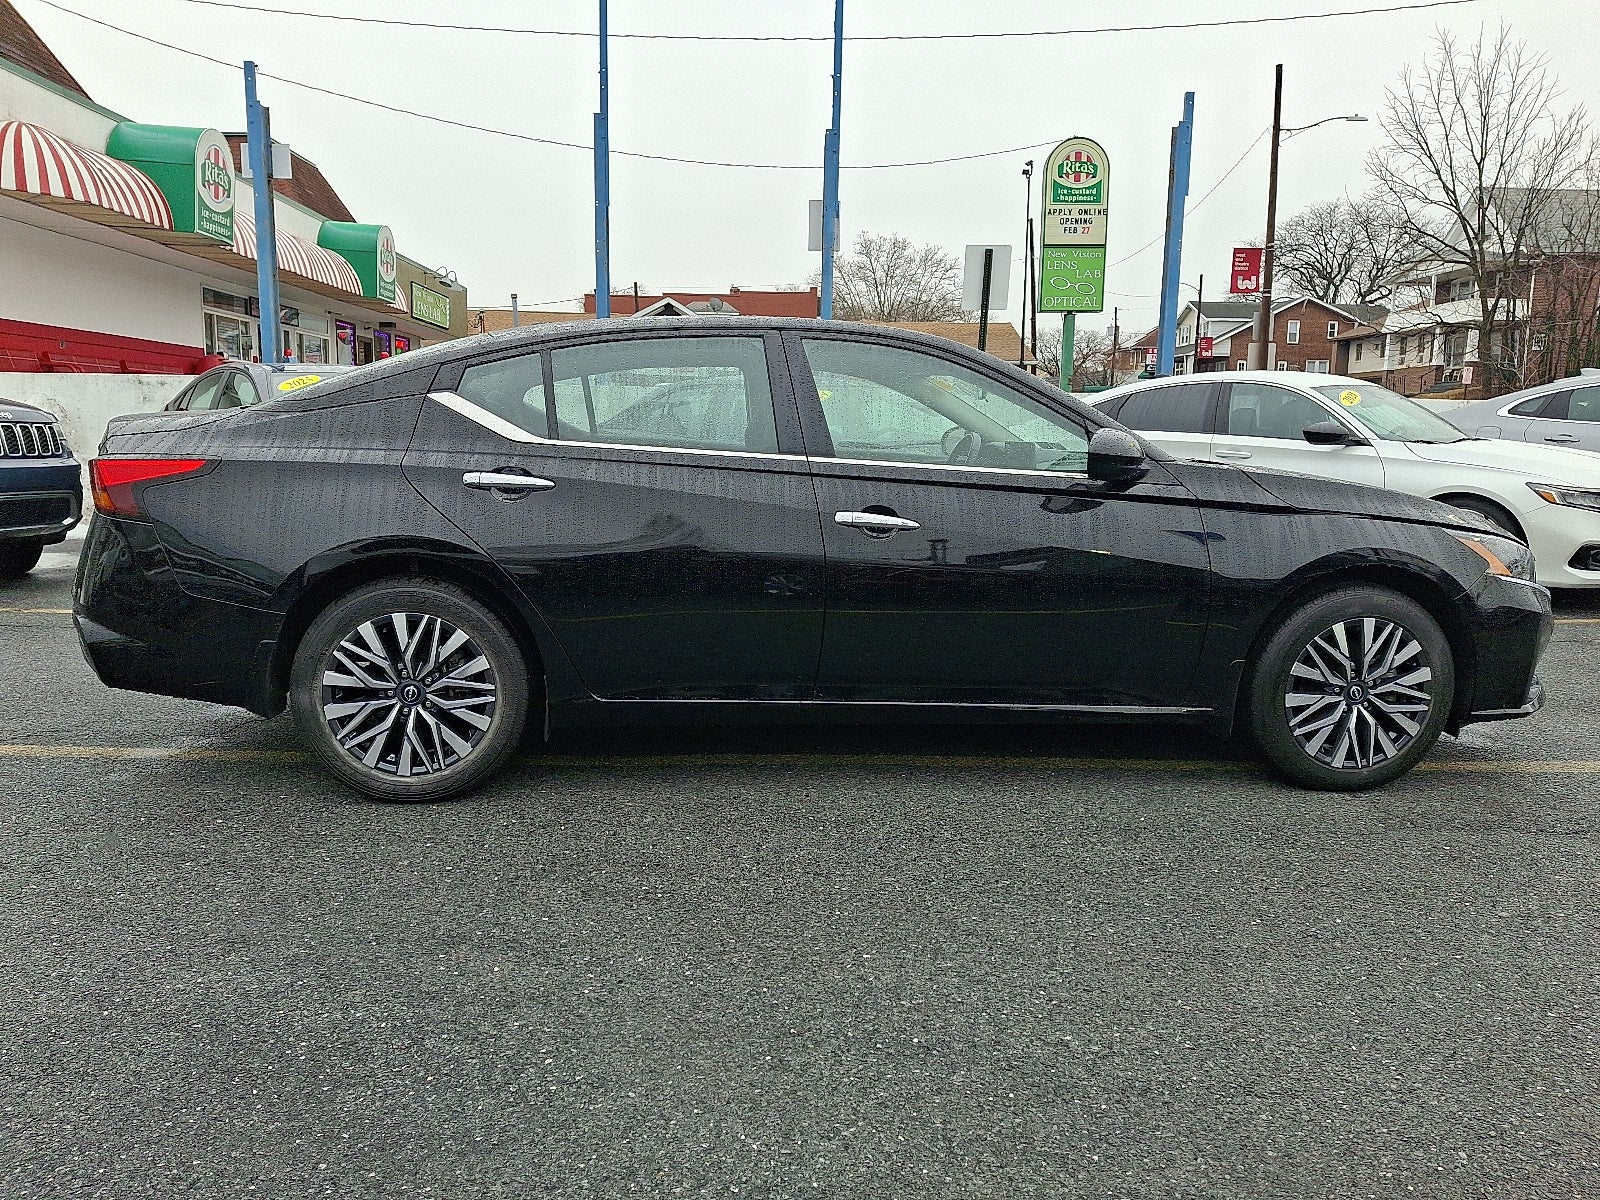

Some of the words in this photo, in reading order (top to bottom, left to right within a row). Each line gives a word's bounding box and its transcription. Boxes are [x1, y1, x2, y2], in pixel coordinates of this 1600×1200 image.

[1062, 160, 1095, 174] Rita's
[205, 159, 229, 190] Rita's
[1047, 208, 1073, 216] APPLY
[1077, 208, 1108, 216] ONLINE
[1059, 217, 1093, 226] OPENING
[1063, 226, 1078, 234] FEB
[1081, 226, 1091, 234] 27
[1047, 250, 1068, 258] New
[1072, 250, 1102, 258] Vision
[1046, 260, 1078, 270] LENS
[1076, 269, 1102, 279] LAB
[1043, 296, 1100, 308] OPTICAL
[413, 299, 428, 317] LENS
[429, 304, 441, 321] LAB
